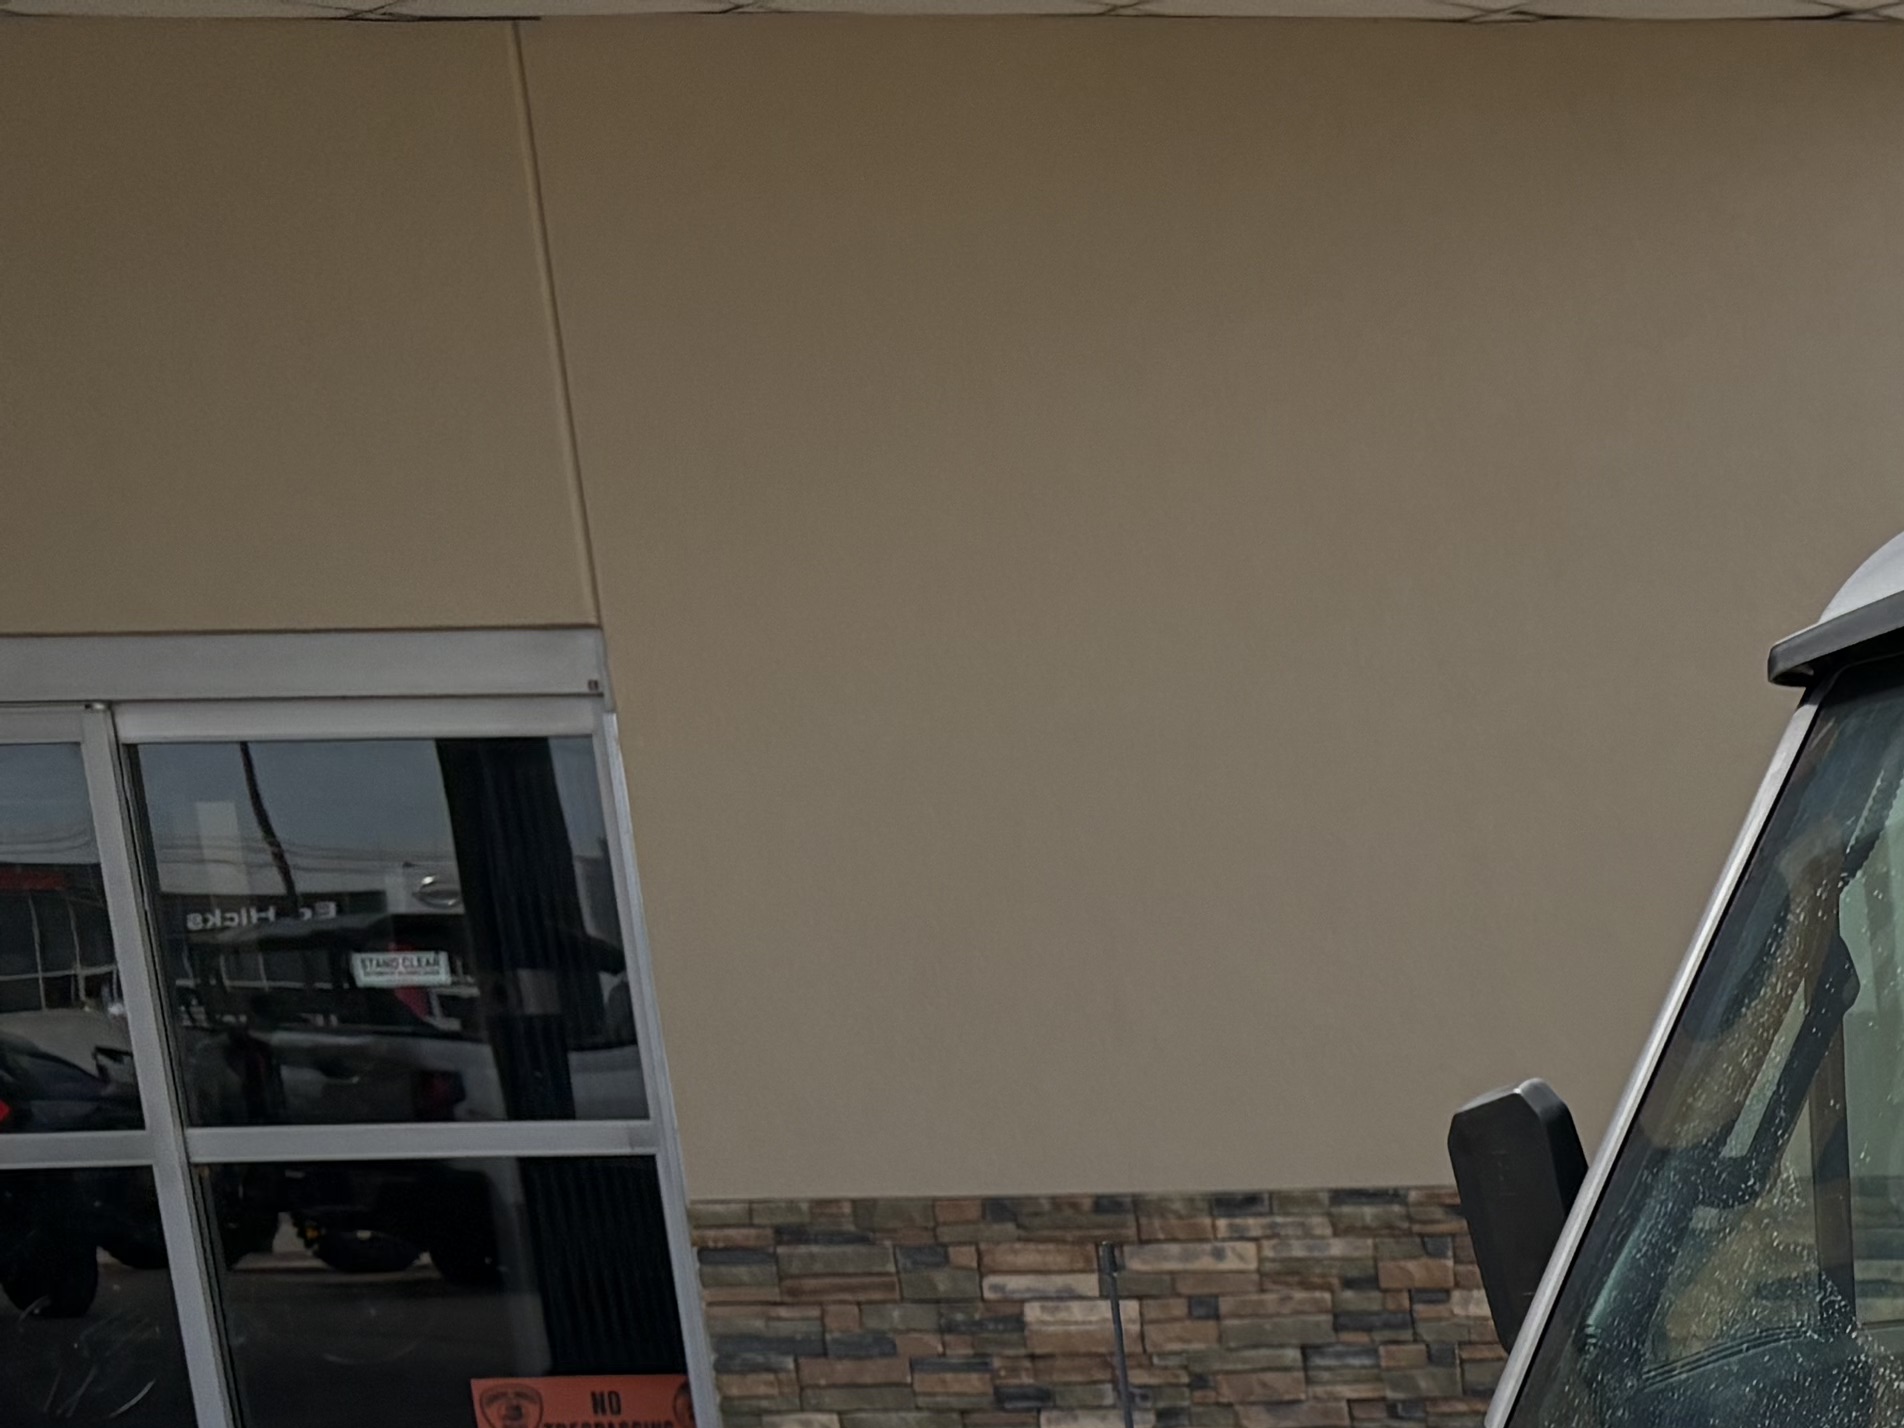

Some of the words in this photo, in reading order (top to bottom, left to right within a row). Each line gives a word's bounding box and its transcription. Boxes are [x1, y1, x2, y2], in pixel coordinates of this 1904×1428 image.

[361, 957, 399, 971] STAND
[401, 955, 441, 970] CLEAR
[590, 1390, 622, 1416] NO
